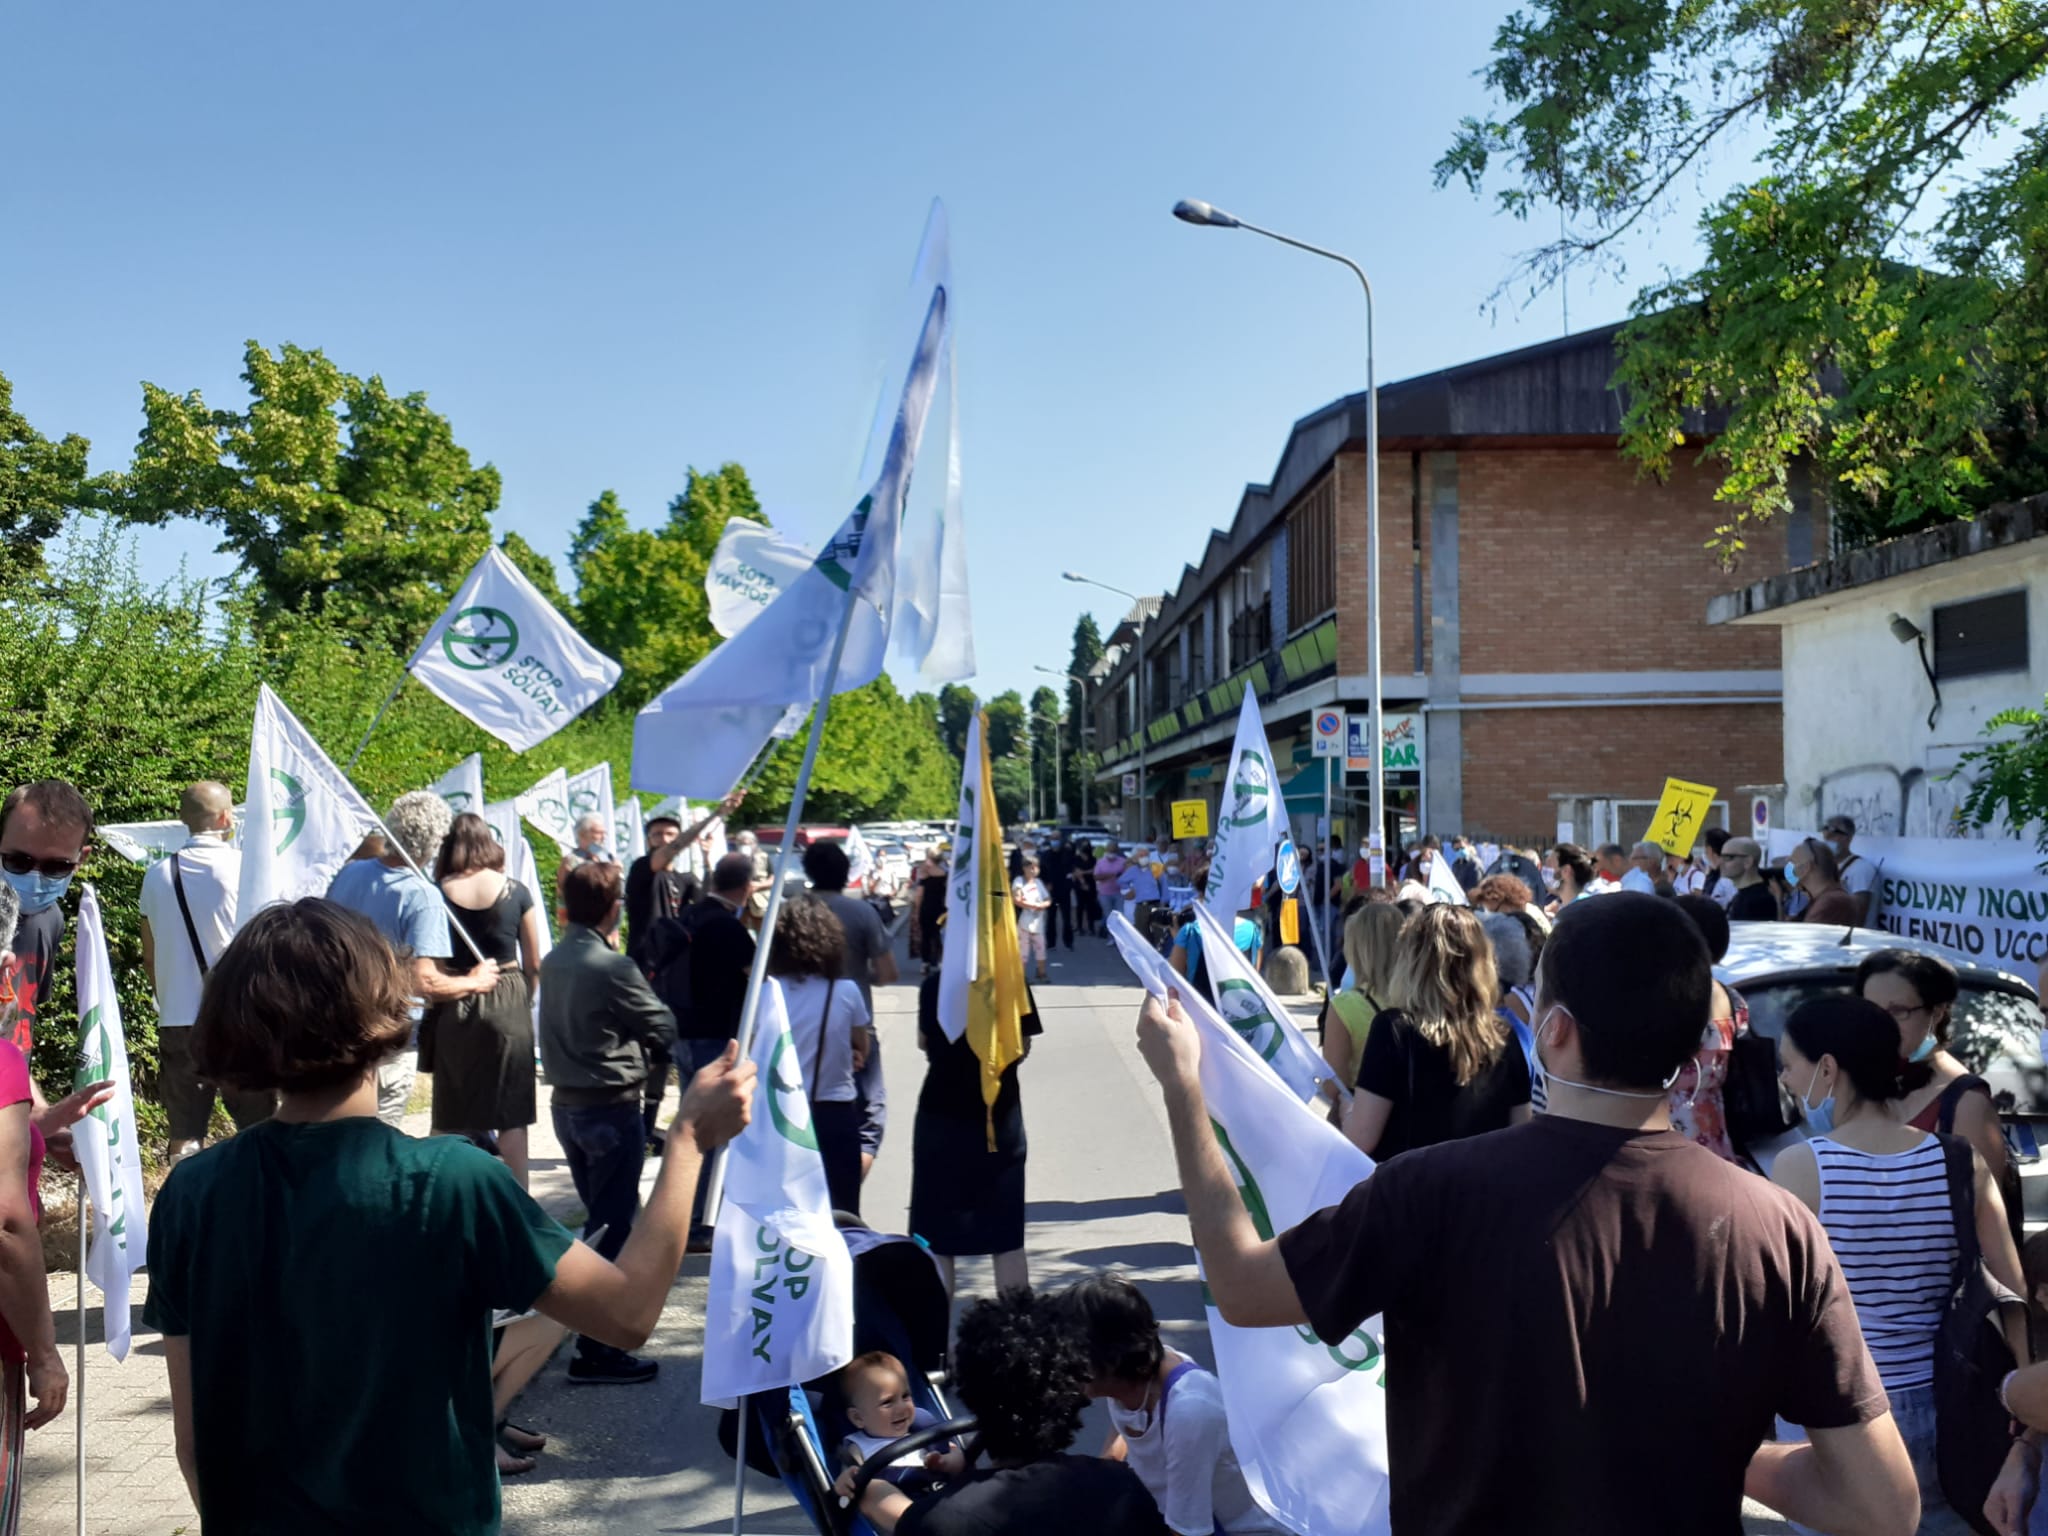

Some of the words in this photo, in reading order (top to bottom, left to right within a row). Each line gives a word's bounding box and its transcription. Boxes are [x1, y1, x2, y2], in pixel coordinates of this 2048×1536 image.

[502, 668, 565, 715] SOLVAY
[518, 655, 563, 688] STOP
[1383, 742, 1419, 768] BAR
[1882, 878, 1967, 914] SOLVAY
[1878, 914, 1984, 955] SILENZIO
[783, 1247, 815, 1300] OP
[751, 1225, 781, 1364] OLVAY
